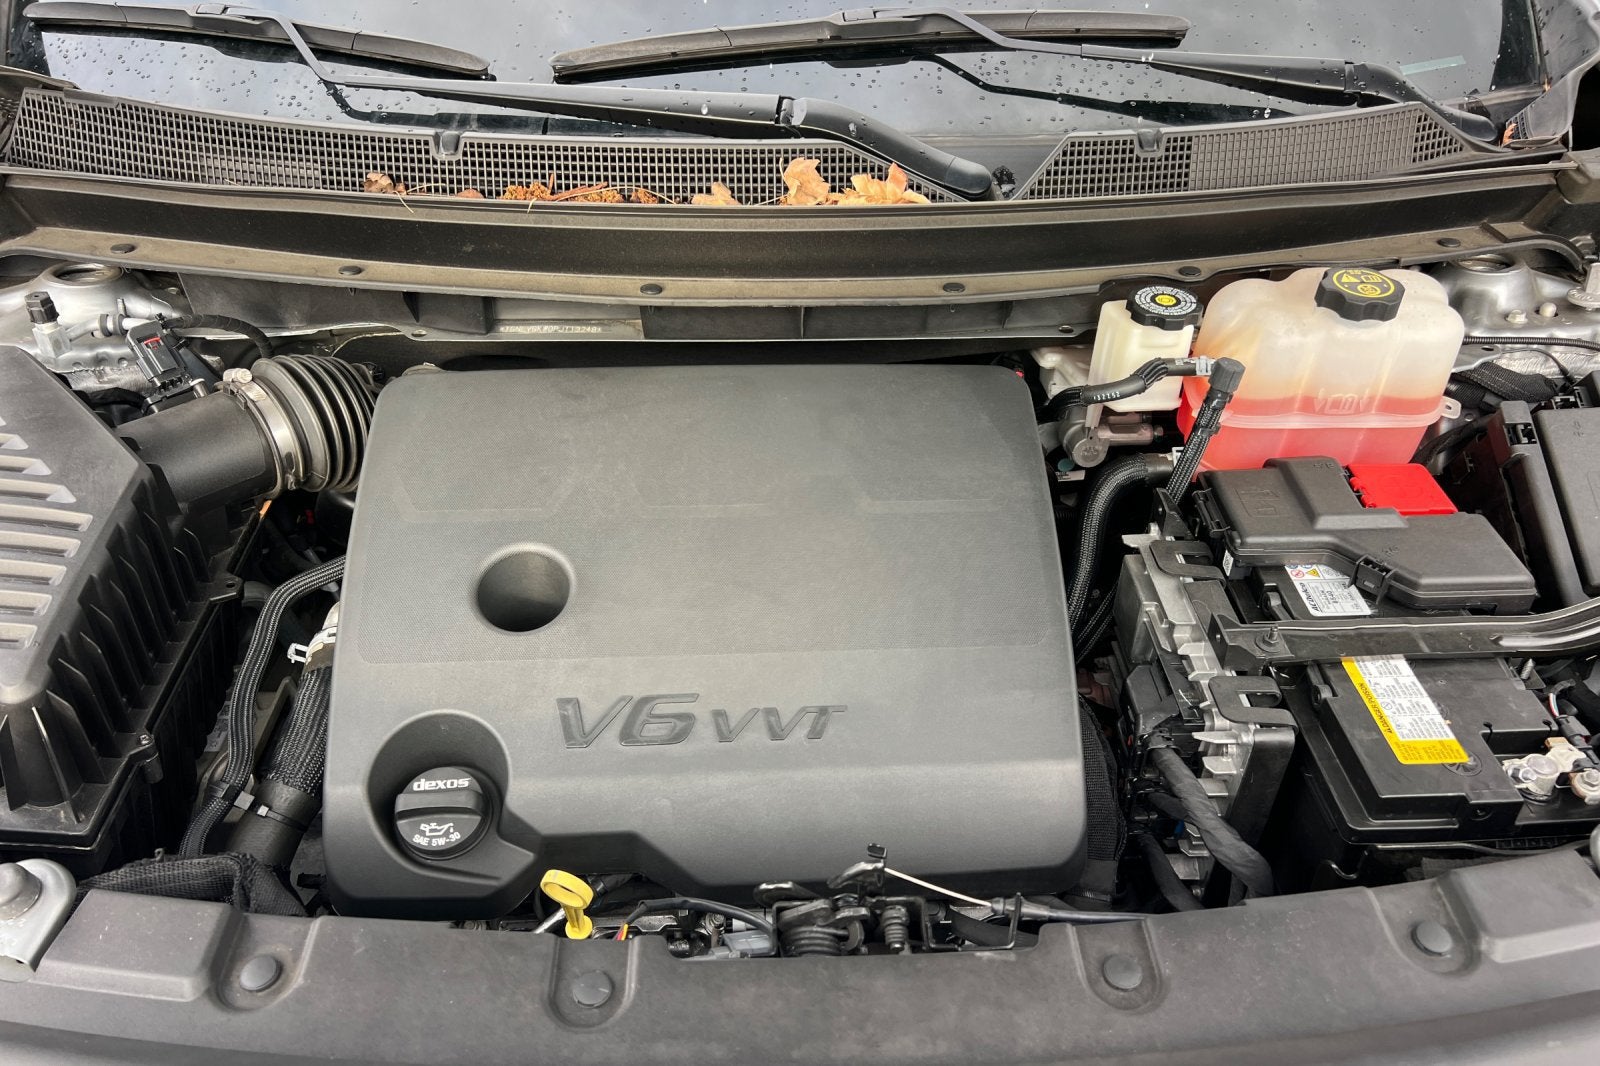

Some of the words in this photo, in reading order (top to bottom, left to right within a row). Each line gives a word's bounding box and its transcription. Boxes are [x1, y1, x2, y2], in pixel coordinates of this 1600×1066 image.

[555, 692, 700, 749] V6
[711, 704, 848, 743] VVT
[413, 778, 472, 791] dexos
[413, 834, 430, 846] SAE
[432, 831, 461, 846] 5W-30
